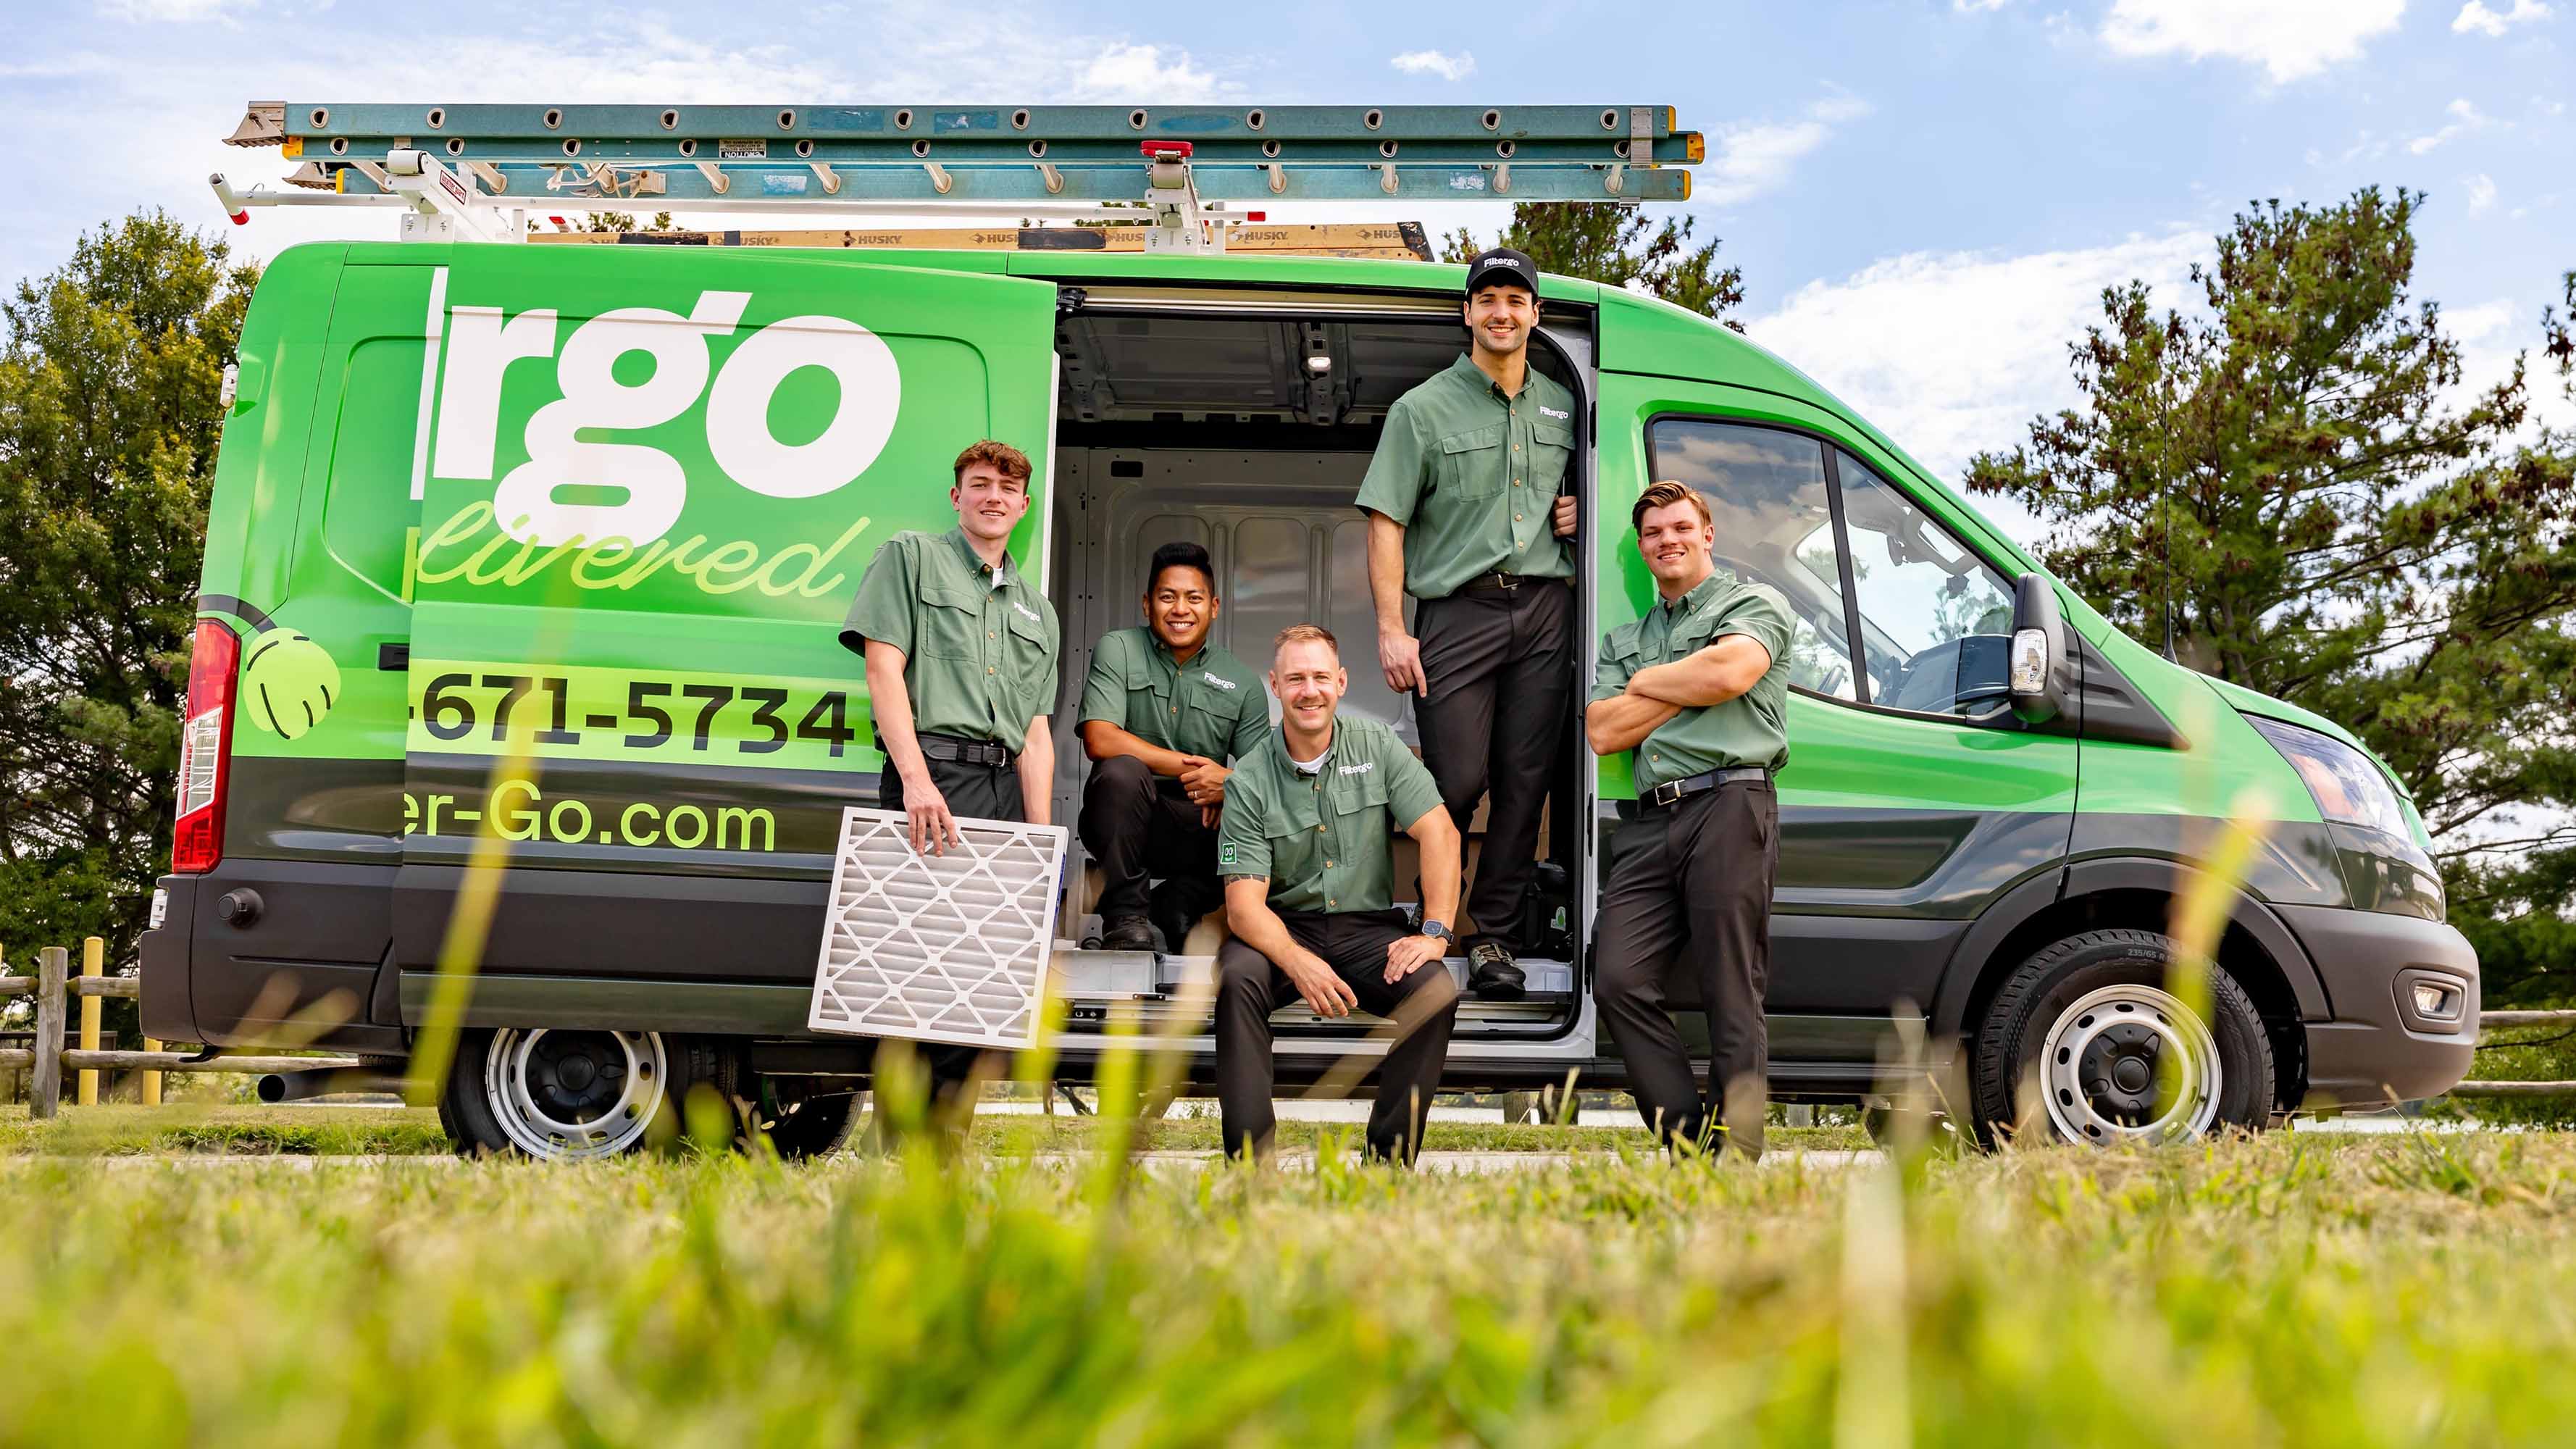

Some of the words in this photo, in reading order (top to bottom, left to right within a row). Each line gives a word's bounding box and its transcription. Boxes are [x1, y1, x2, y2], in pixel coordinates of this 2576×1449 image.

[858, 235, 903, 244] HUSKY
[987, 233, 1018, 243] HUS
[1115, 233, 1145, 243] HUS
[1373, 230, 1400, 238] HUS
[740, 237, 775, 246] USKY
[1484, 257, 1520, 268] Filtergo
[1539, 406, 1568, 419] Filtergo
[432, 290, 901, 551] rgo
[416, 500, 871, 598] livered
[1204, 672, 1236, 689] Filtergo
[409, 672, 855, 758] 671-5734
[1339, 762, 1373, 776] Filtergo
[2128, 948, 2157, 958] 235/65
